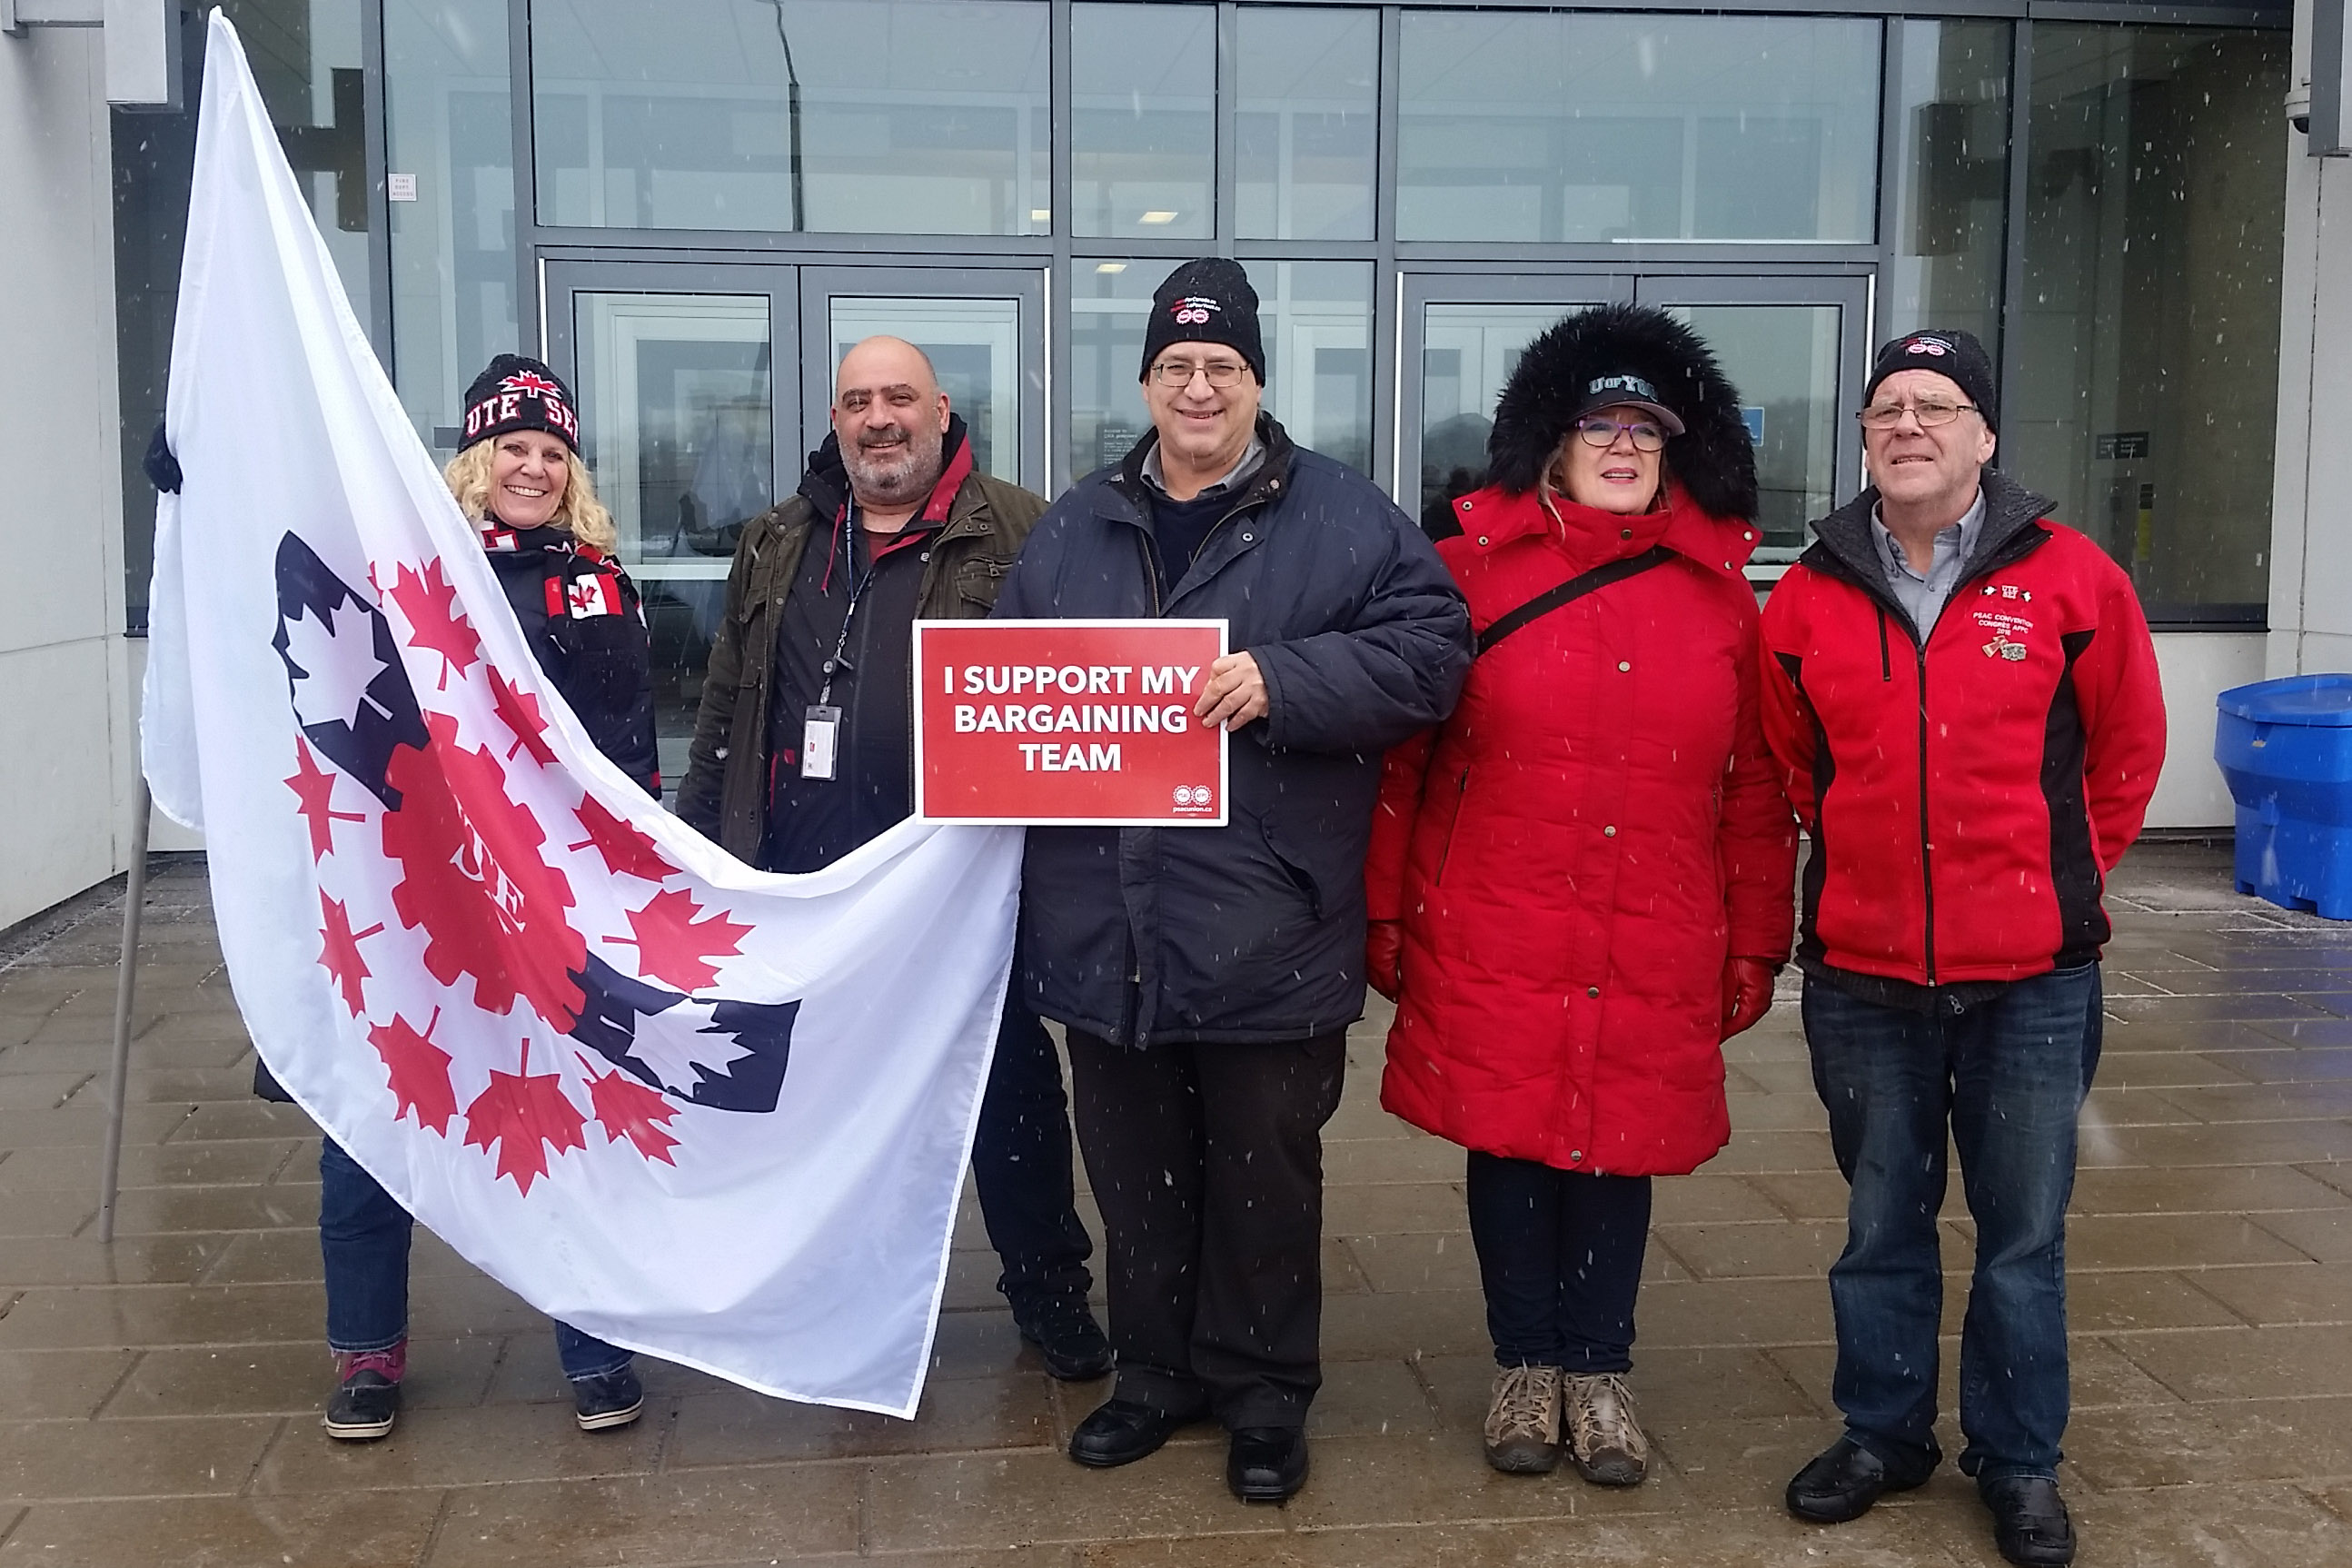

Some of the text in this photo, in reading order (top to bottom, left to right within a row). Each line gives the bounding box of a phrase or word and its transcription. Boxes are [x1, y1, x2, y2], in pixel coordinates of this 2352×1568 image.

[466, 392, 521, 436] UTE
[1972, 611, 2034, 629] PSAC CONVENTION
[944, 664, 1201, 695] I SUPPORT MY
[954, 704, 1188, 733] BARGAINING
[1018, 743, 1122, 771] TEAM
